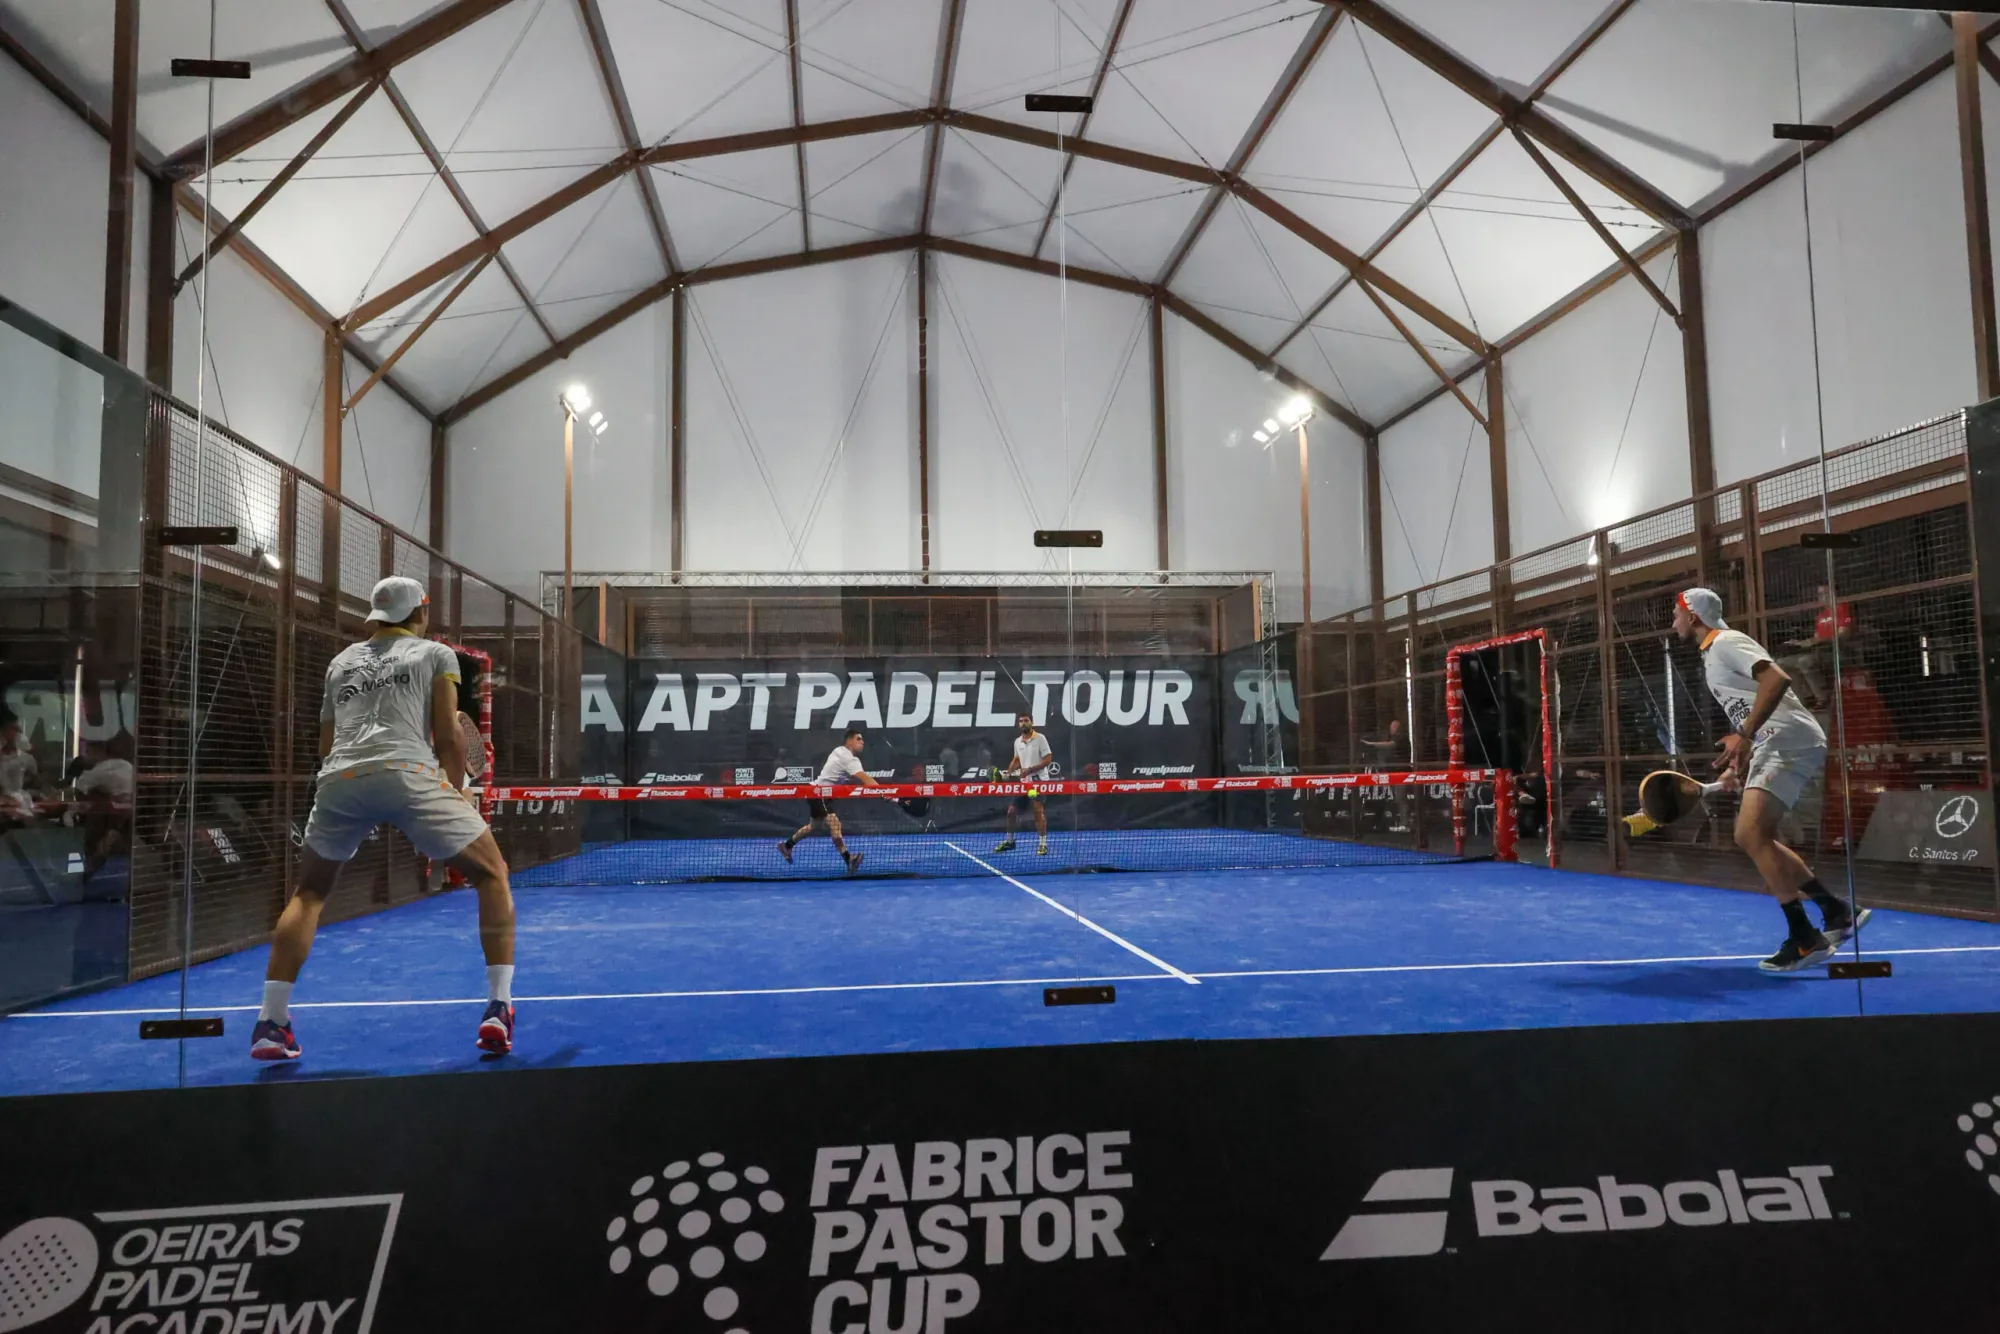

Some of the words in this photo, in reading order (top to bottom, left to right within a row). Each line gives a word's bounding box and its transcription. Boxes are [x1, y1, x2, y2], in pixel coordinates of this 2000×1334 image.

[361, 673, 411, 693] Macro
[637, 673, 787, 731] APT
[794, 671, 1016, 730] PADEL
[1022, 669, 1193, 727] TOUR
[963, 785, 984, 794] APT
[988, 784, 1028, 794] PADEL
[1032, 783, 1064, 793] TOUR
[1112, 781, 1166, 792] royalpadel
[1132, 764, 1195, 776] royalpadel
[1922, 847, 1959, 860] Santos
[809, 1130, 1134, 1207] FABRICE
[112, 1217, 305, 1267] OEIRAS
[808, 1194, 1127, 1277] PASTOR
[89, 1262, 260, 1312] PADEL
[810, 1272, 981, 1334] CUP
